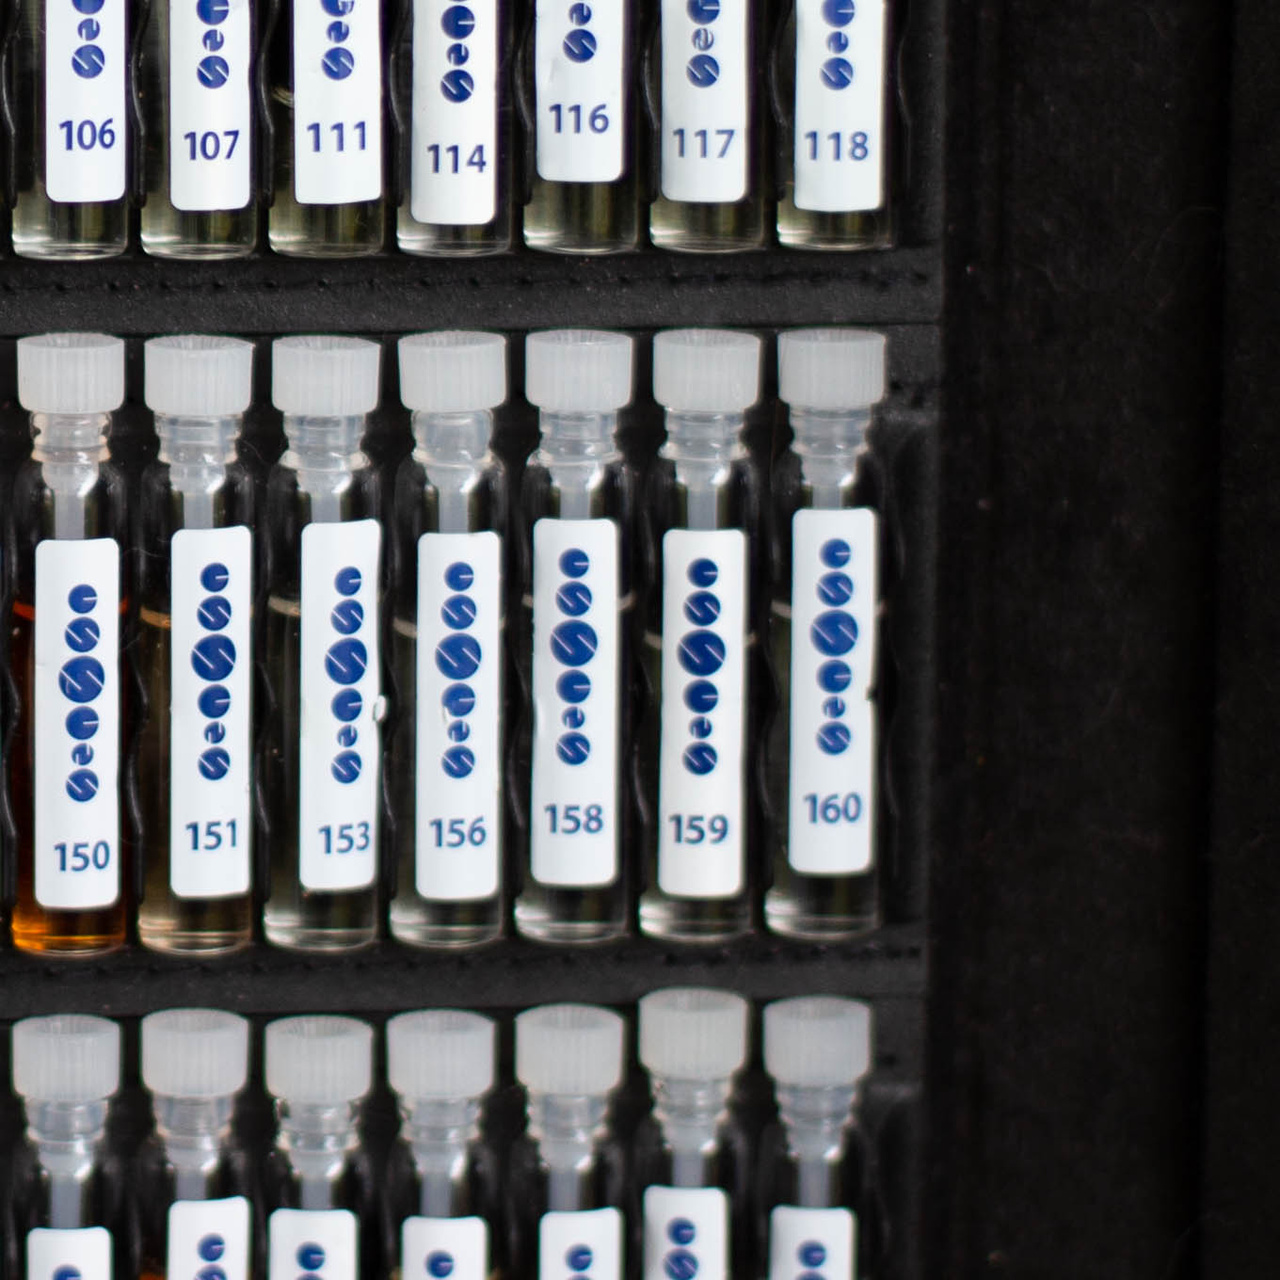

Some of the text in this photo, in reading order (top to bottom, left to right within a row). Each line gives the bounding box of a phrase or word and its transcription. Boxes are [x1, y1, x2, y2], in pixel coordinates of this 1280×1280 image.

[549, 103, 610, 134] 116
[59, 118, 116, 151] 106
[183, 129, 240, 161] 107
[307, 120, 366, 153] 111
[672, 127, 736, 159] 117
[805, 130, 869, 161] 118
[427, 143, 487, 174] 114
[544, 804, 604, 835] 158
[805, 793, 862, 824] 160
[186, 820, 237, 851] 151
[319, 822, 370, 855] 153
[430, 817, 487, 848] 156
[669, 814, 729, 845] 159
[54, 841, 110, 872] 150
